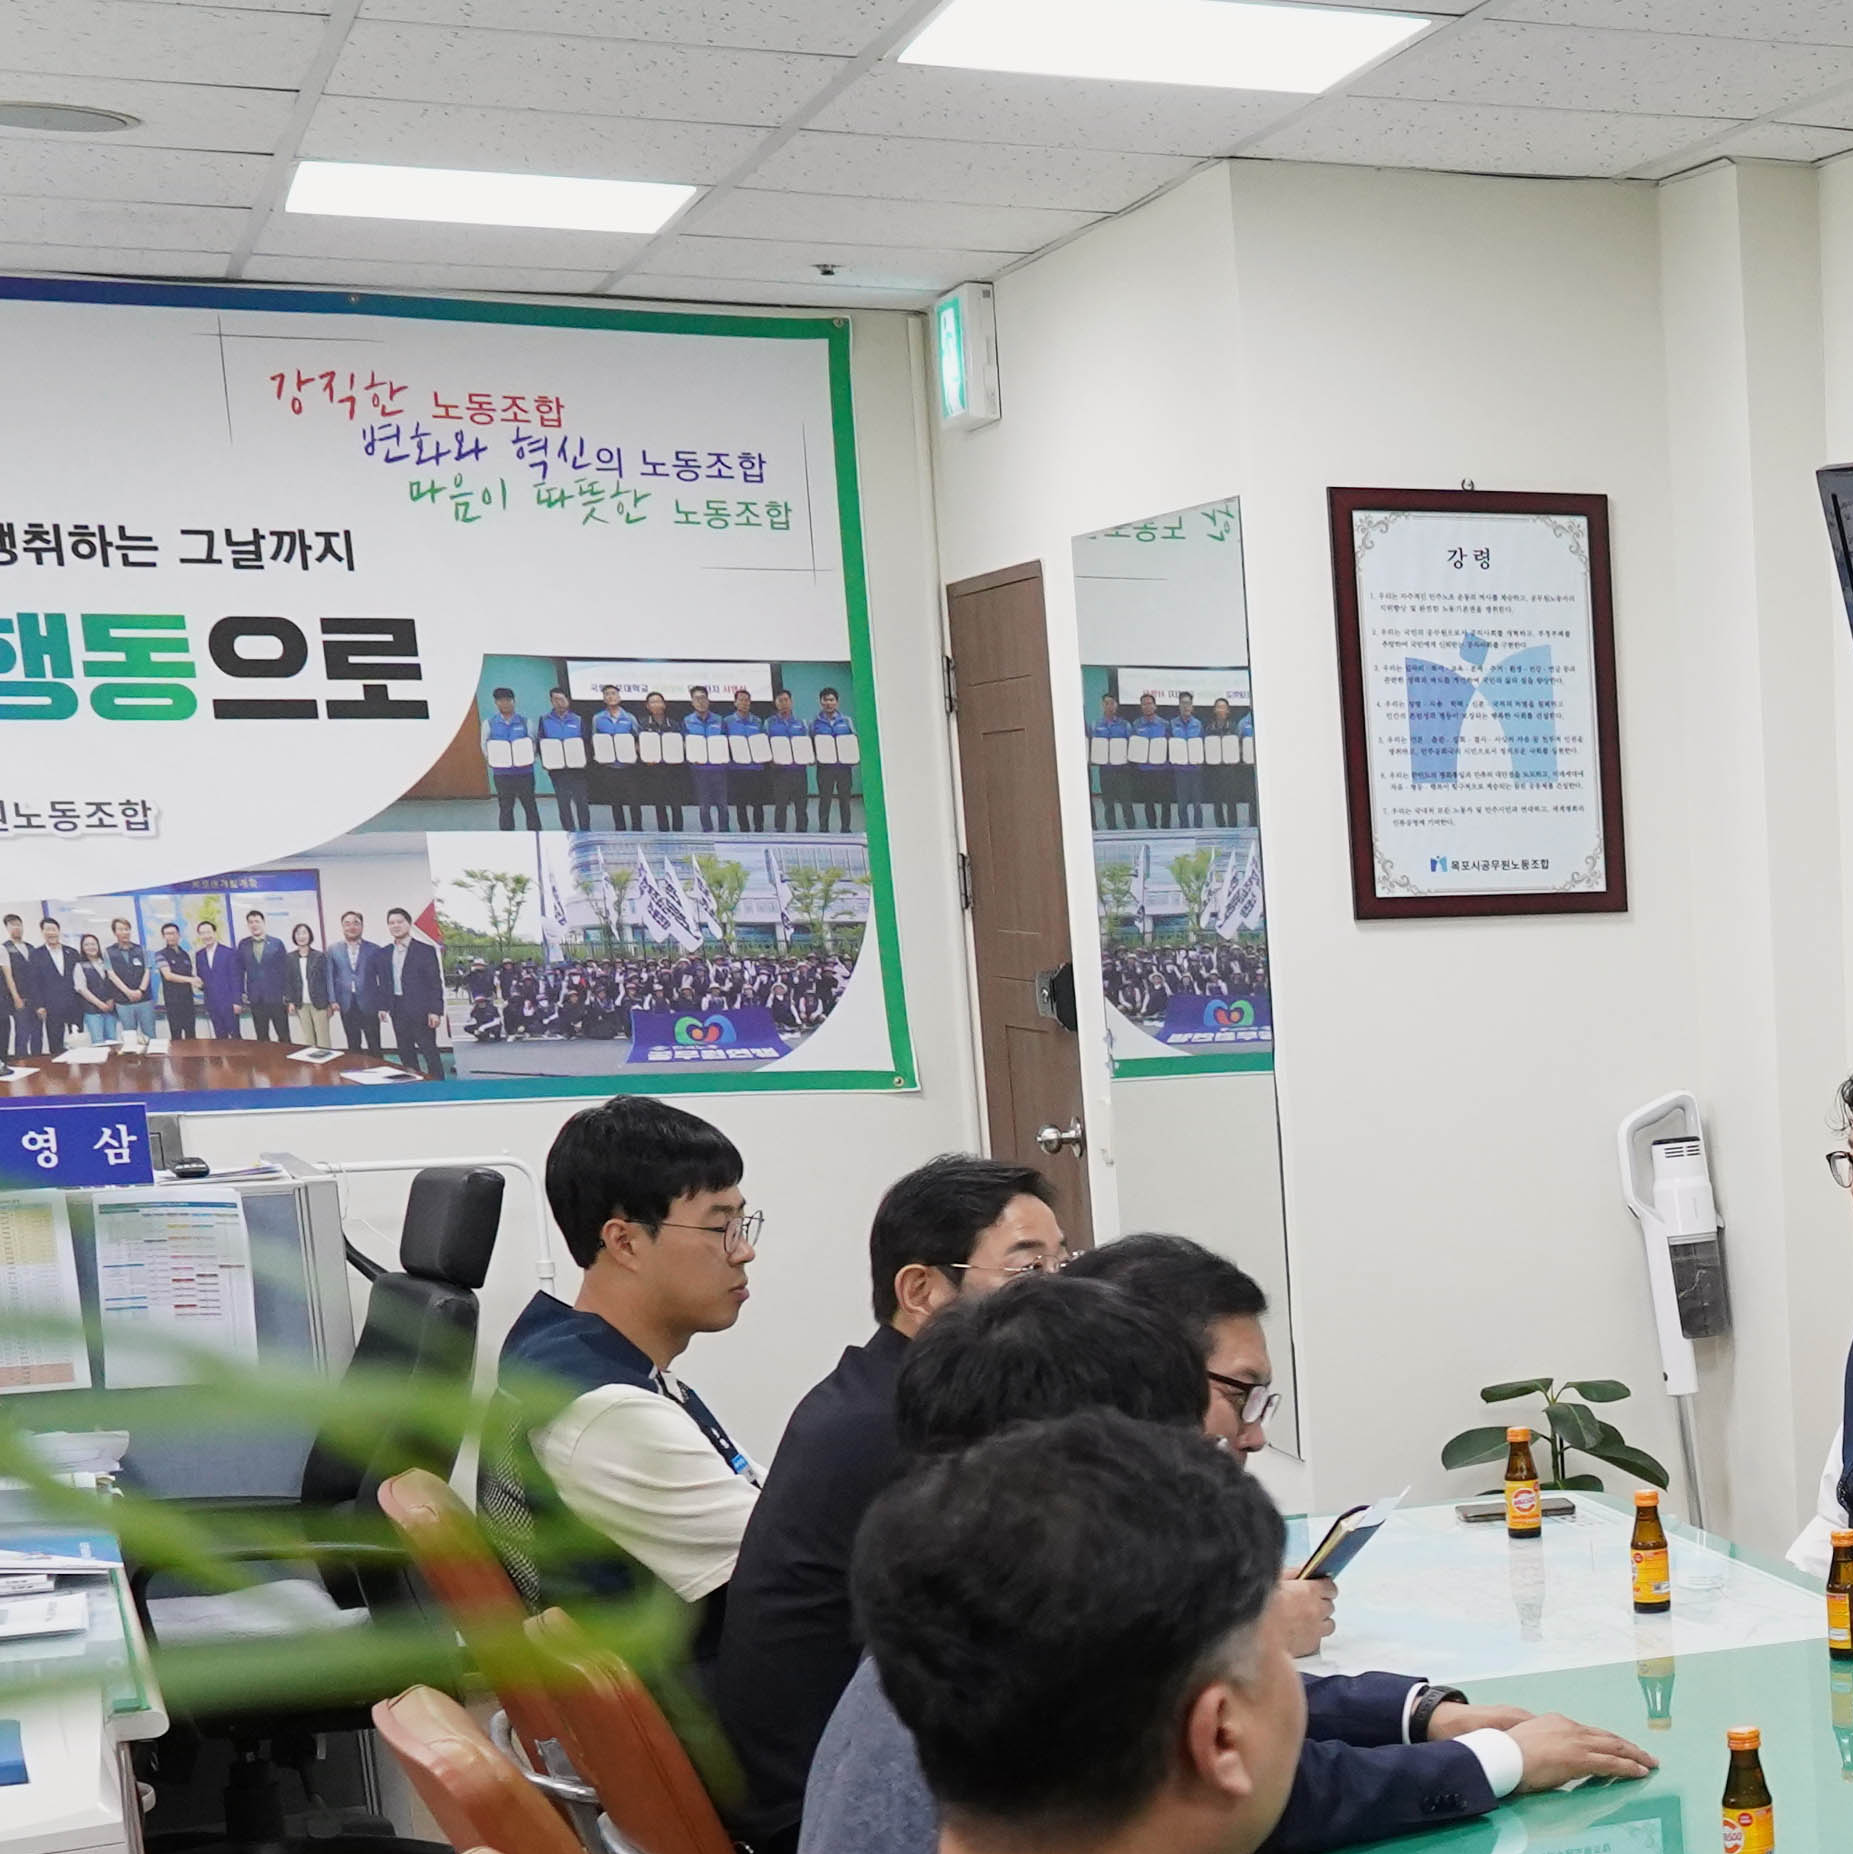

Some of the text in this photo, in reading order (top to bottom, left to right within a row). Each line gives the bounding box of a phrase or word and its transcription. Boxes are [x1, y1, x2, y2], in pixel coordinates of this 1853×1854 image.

[270, 368, 565, 429] 강직한 노동조합
[362, 421, 767, 484] 변화와 혁신의 노동조합
[409, 472, 793, 531] 마음이 따뜻한 노동조합
[178, 528, 356, 572] 그날까지
[1447, 547, 1490, 570] 강령
[1449, 857, 1550, 873] 목포시공무원노동조합
